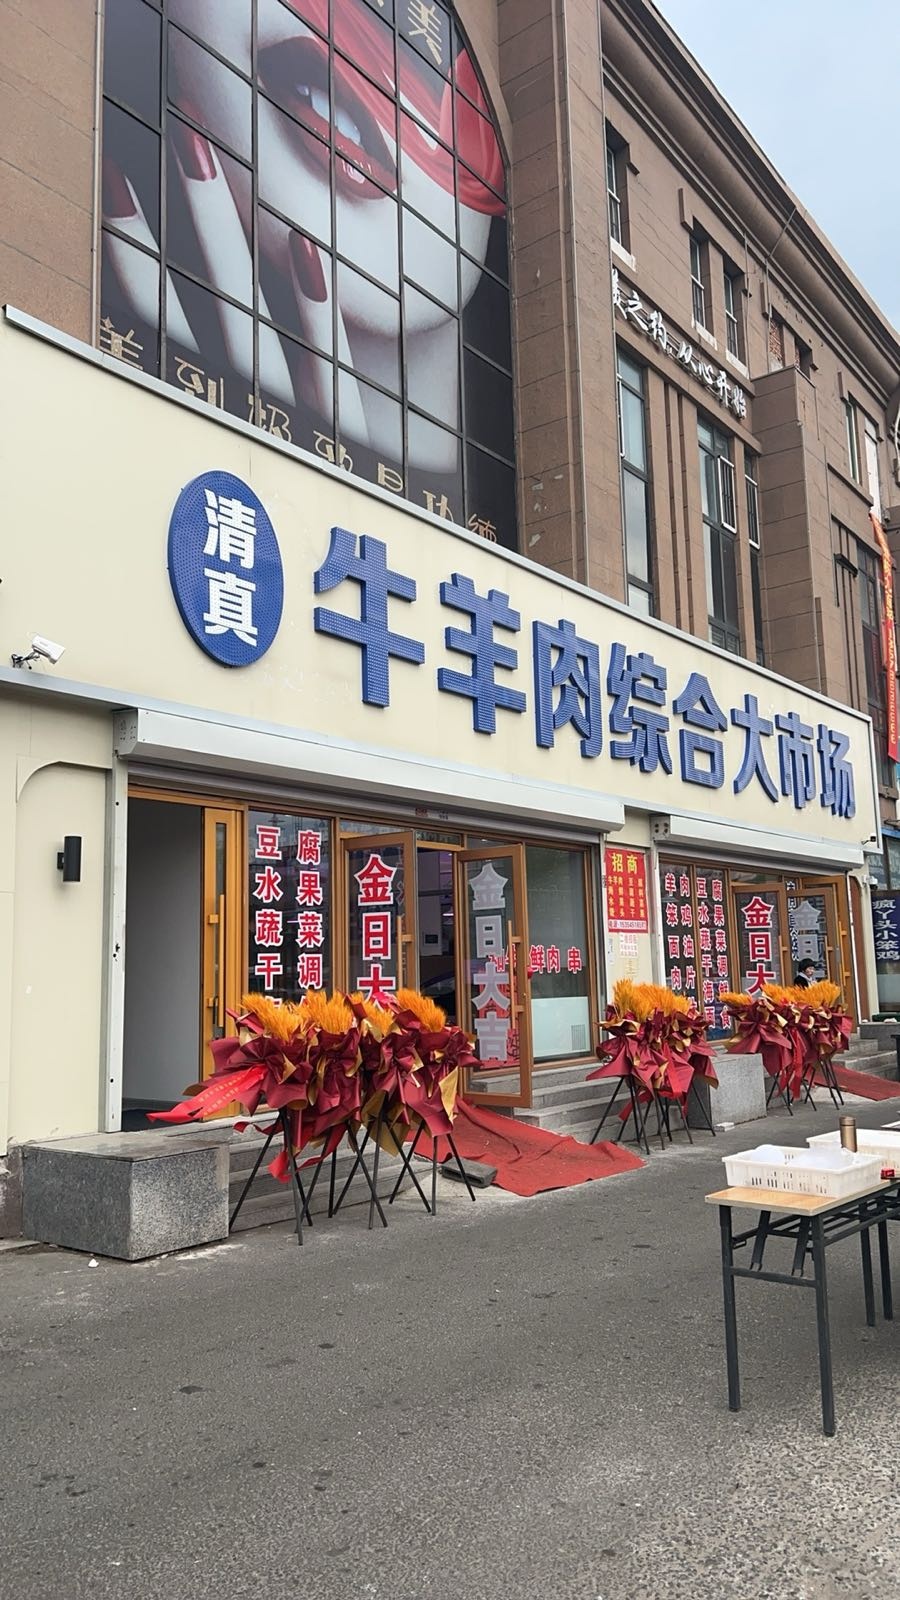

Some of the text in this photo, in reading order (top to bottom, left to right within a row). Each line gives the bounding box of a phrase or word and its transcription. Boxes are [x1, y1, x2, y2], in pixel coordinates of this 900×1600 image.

[203, 488, 258, 647] 清真
[313, 526, 856, 819] 牛羊肉综合大市场
[255, 825, 321, 866] 豆腐
[611, 852, 638, 874] 招商
[253, 866, 323, 906] 水果
[665, 873, 691, 898] 羊肉
[696, 877, 722, 901] 豆腐
[666, 903, 692, 927] 笨鸡
[698, 902, 724, 926] 水果
[254, 909, 324, 948] 蔬菜
[700, 927, 727, 953] 蔬菜
[872, 899, 900, 961] 疯丫头小笨鸡
[255, 953, 323, 991] 干调
[671, 965, 696, 990] 肉片
[702, 954, 729, 978] 干调
